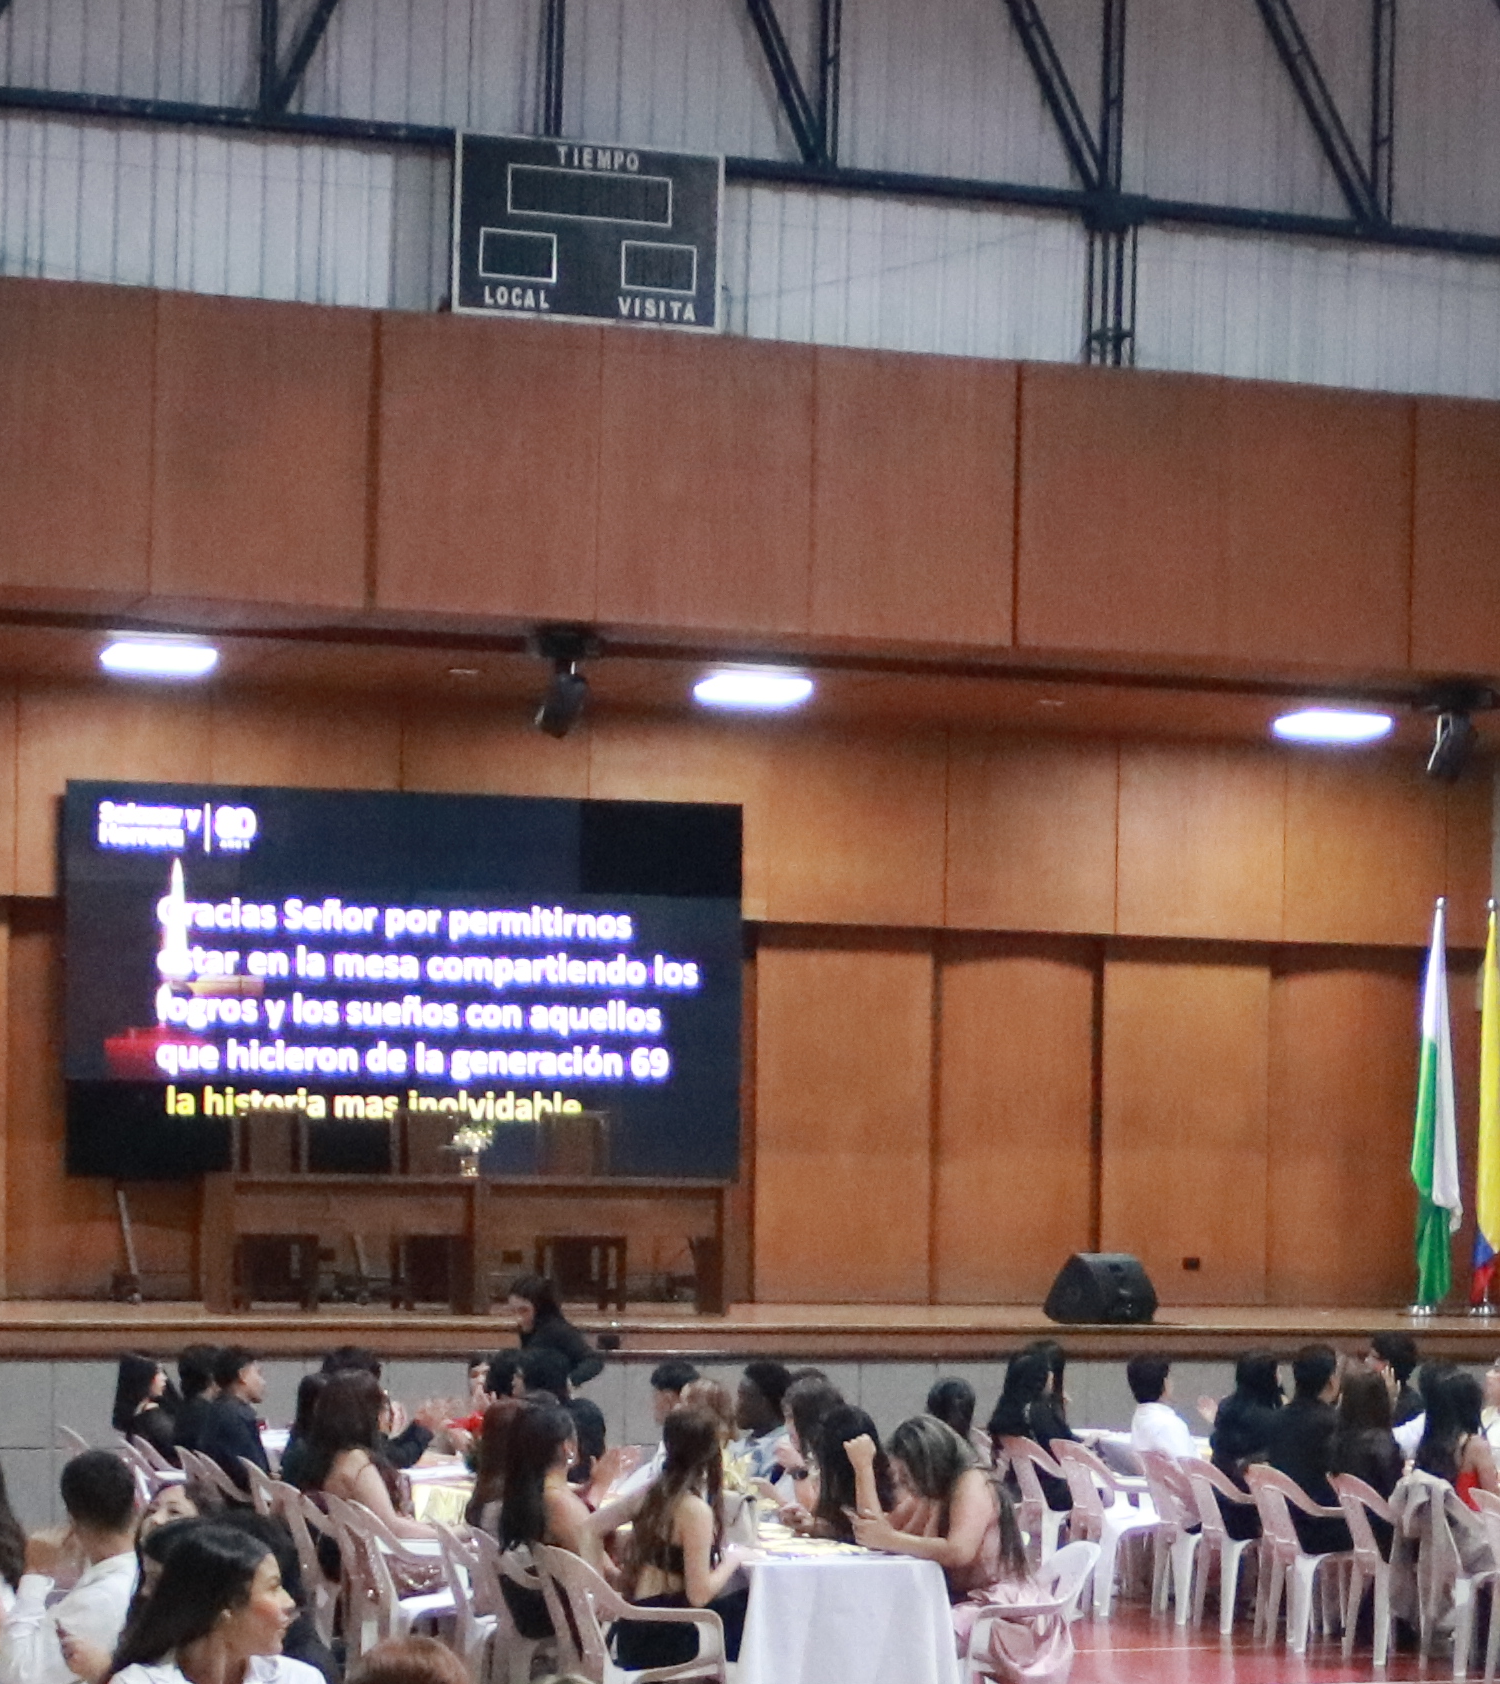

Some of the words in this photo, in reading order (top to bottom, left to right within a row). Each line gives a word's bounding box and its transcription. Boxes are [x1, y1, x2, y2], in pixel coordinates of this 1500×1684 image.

[557, 145, 639, 171] TIEMPO
[484, 285, 550, 309] LOCAL
[618, 297, 696, 322] VISITA
[157, 895, 277, 928] Gracias
[284, 898, 378, 931] Señor
[385, 907, 442, 939] por
[449, 905, 632, 940] permitirnos
[156, 945, 240, 976] estar
[247, 950, 289, 976] en
[296, 945, 326, 977] la
[333, 952, 419, 980] mesa
[426, 953, 648, 988] compartiendo
[654, 954, 699, 986] los
[156, 986, 259, 1029] logros
[265, 999, 286, 1030] y
[292, 992, 340, 1024] los
[346, 995, 459, 1028] sueños
[465, 1003, 522, 1028] con
[530, 1000, 662, 1036] aquellos
[155, 1043, 220, 1075] que
[226, 1038, 359, 1072] hicieron
[365, 1040, 407, 1072] de
[414, 1041, 445, 1074] la
[450, 1045, 623, 1080] generación
[630, 1047, 670, 1079] 69
[166, 1085, 195, 1116] la
[203, 1085, 327, 1118] historia
[333, 1094, 400, 1119] mas
